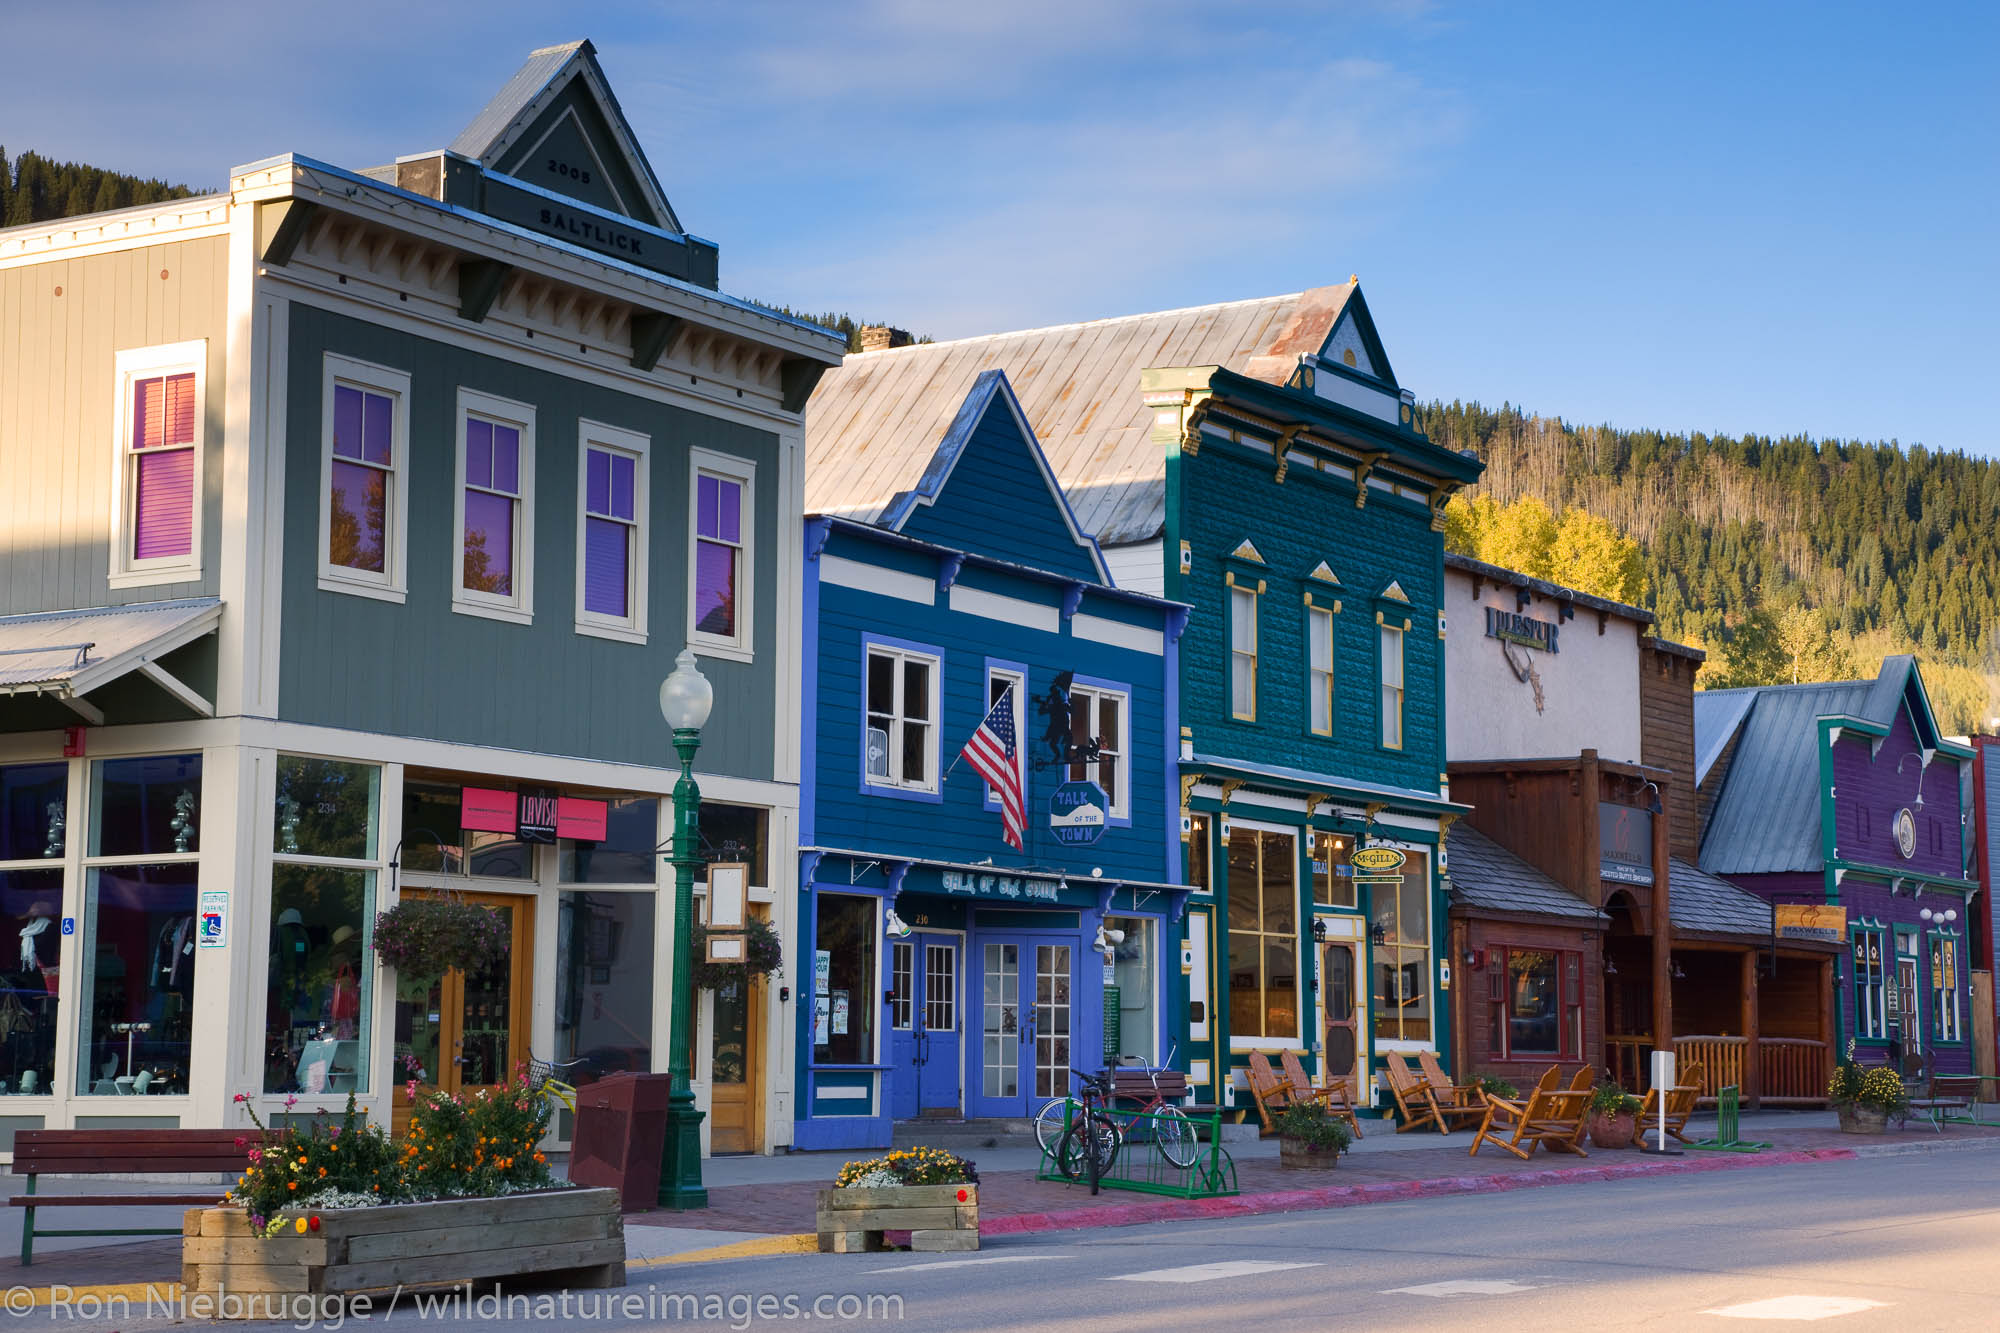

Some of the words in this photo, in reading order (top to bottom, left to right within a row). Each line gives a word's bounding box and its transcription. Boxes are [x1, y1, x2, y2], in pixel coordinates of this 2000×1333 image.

[548, 159, 591, 184] 2005
[540, 208, 642, 255] SALTLICK
[1056, 791, 1088, 805] TALK
[318, 802, 336, 814] 234
[521, 795, 557, 827] LAVISH
[1060, 827, 1092, 841] TOWN
[723, 839, 737, 850] 232
